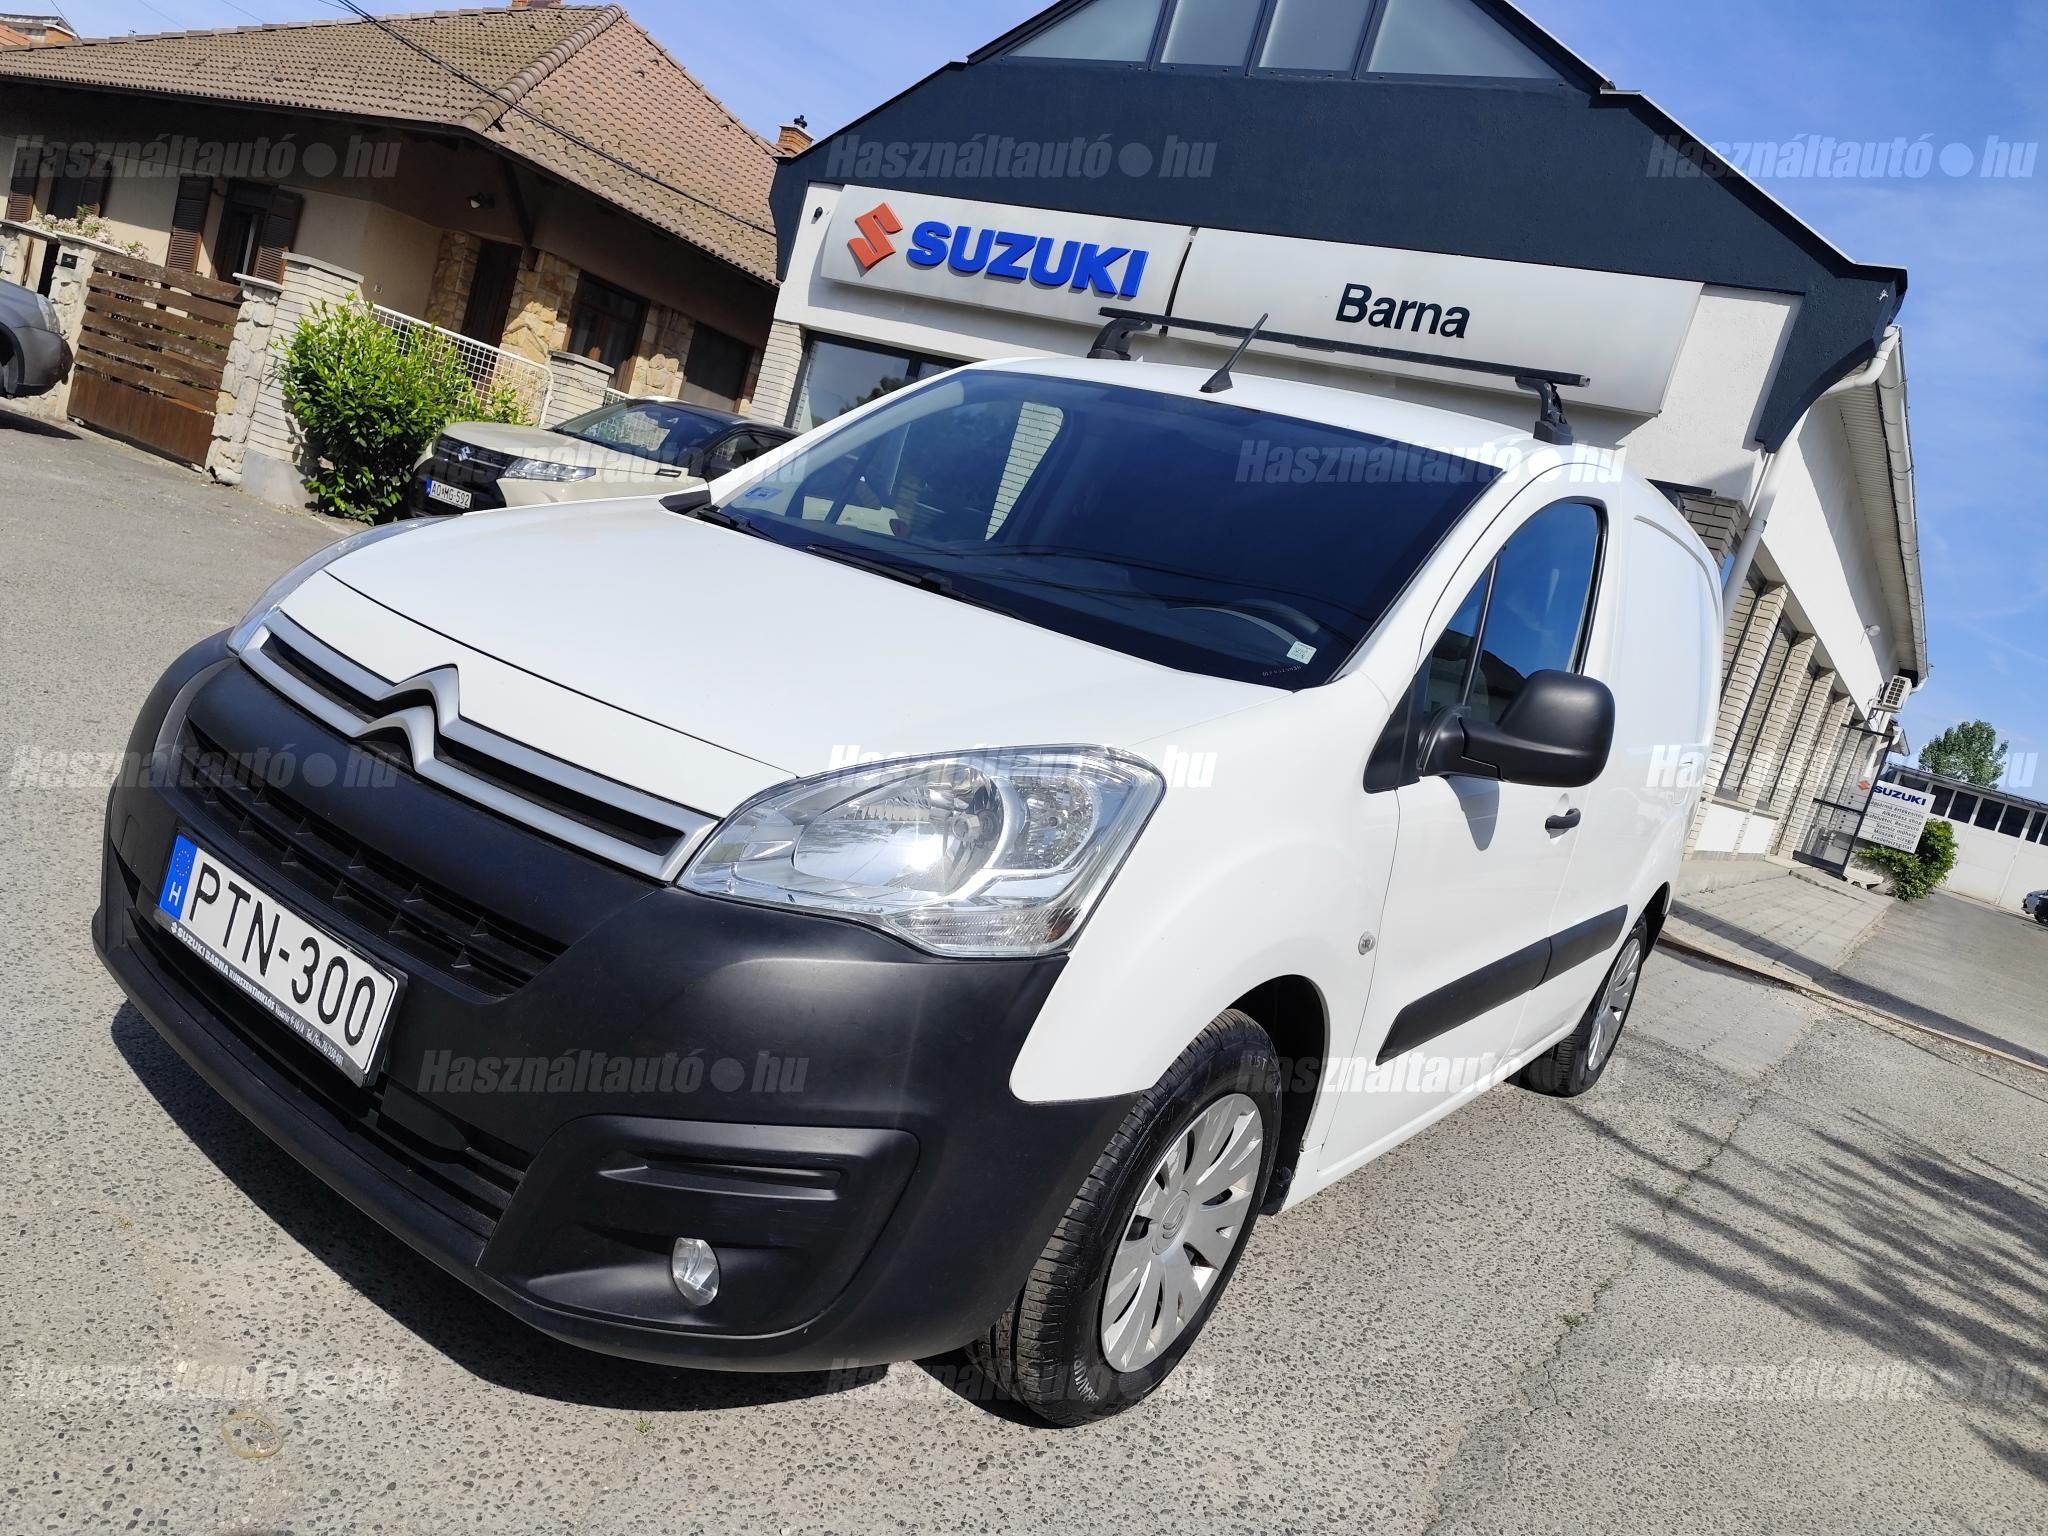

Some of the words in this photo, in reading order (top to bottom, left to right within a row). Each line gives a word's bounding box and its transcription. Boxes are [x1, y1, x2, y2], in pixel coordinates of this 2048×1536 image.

[907, 221, 1149, 298] SUZUKI
[1336, 283, 1470, 338] Barna
[1873, 786, 1927, 806] SUZUKI
[168, 881, 182, 906] H
[177, 927, 205, 956] SUZUKI
[205, 949, 229, 975] BARNA
[189, 862, 376, 1046] PTN-300
